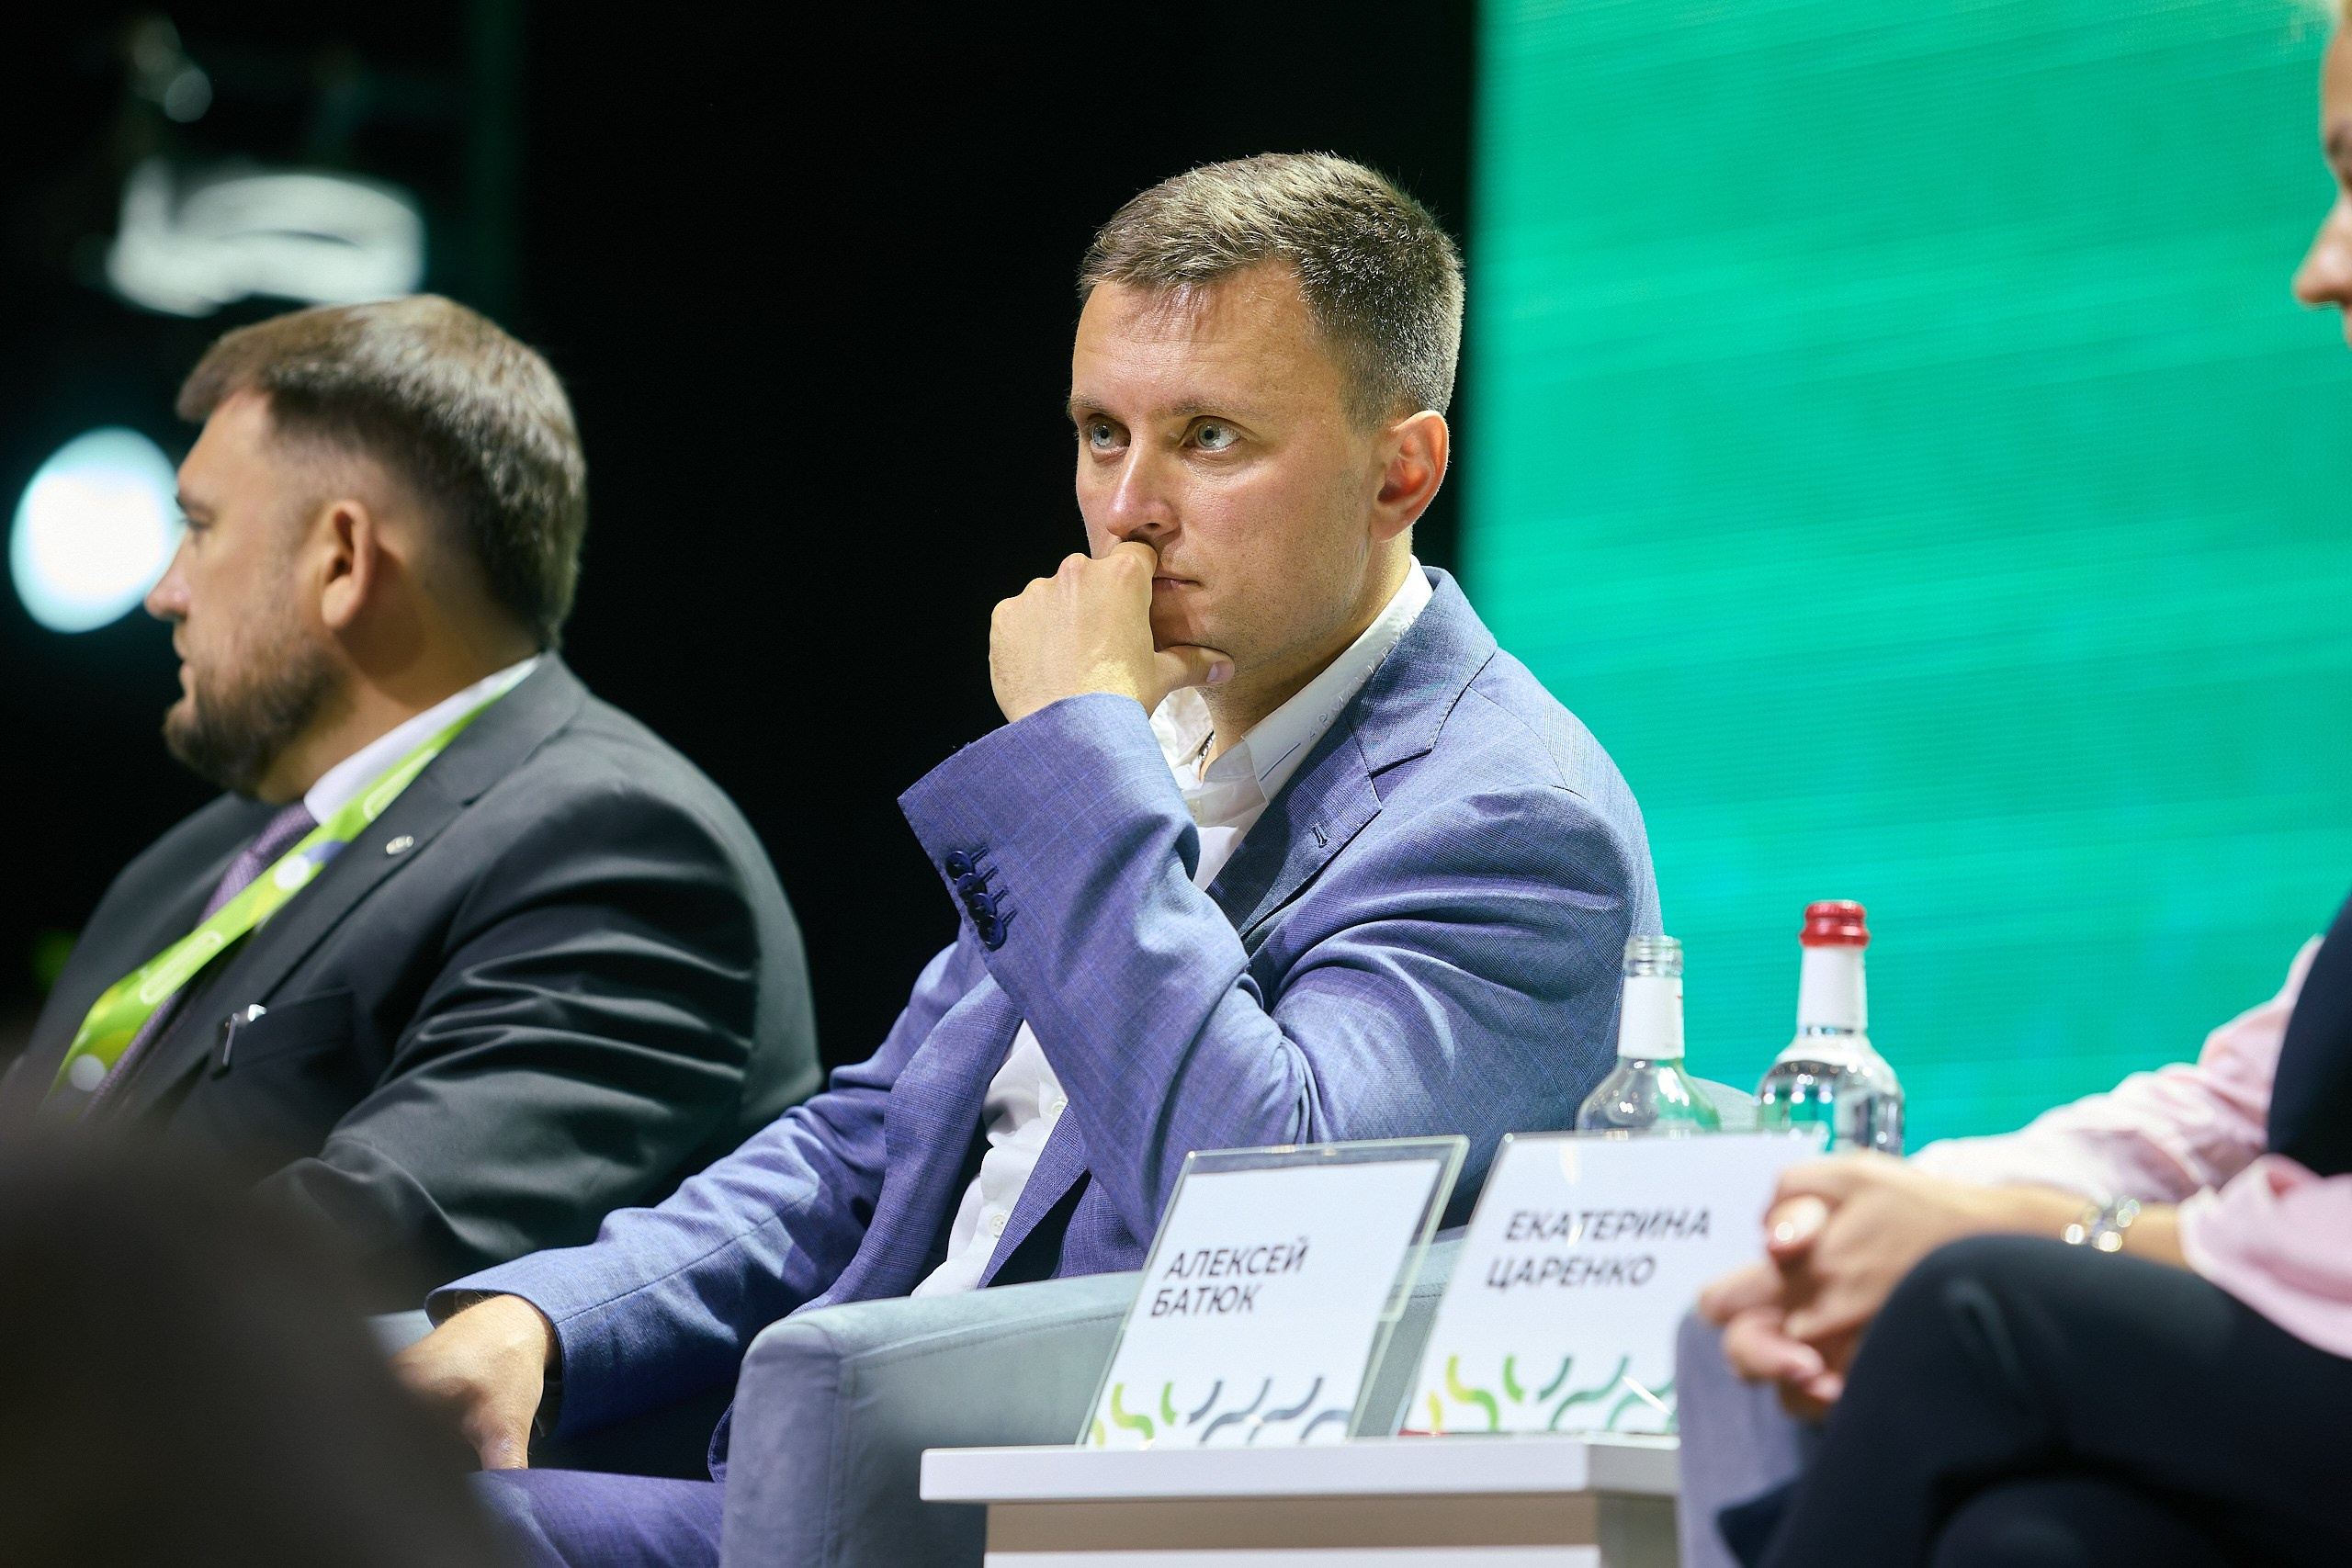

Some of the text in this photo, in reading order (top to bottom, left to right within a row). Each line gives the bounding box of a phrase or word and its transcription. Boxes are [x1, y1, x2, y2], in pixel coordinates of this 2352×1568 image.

[1506, 1209, 1711, 1240] ЕКАТЕРИНА
[1164, 1236, 1308, 1280] АЛЕКСЕЙ
[1487, 1256, 1656, 1292] ЦАРЕНКО
[1151, 1284, 1261, 1317] БАТЮК
